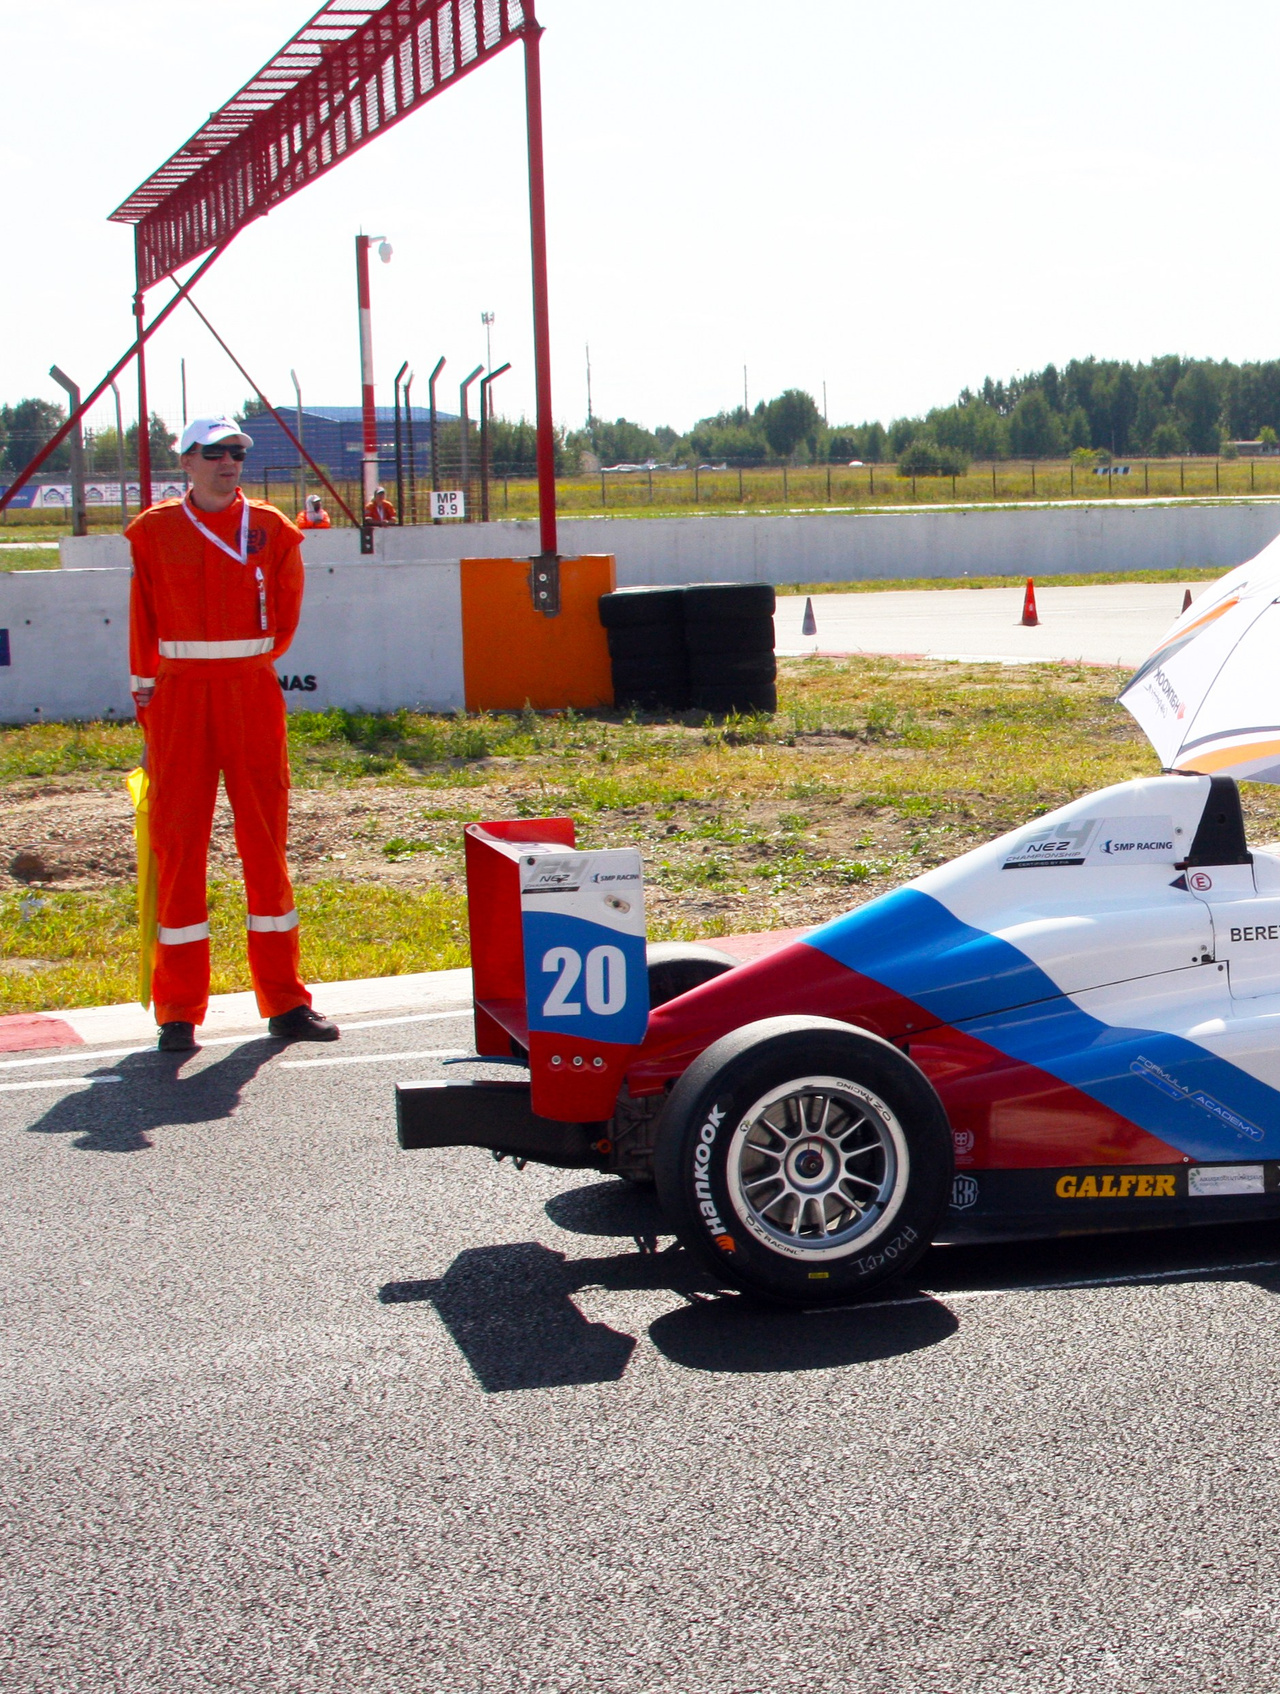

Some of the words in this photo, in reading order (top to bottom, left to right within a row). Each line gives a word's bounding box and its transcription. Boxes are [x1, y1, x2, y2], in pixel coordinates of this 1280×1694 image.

[437, 493, 457, 504] MP
[437, 504, 458, 516] 8.9
[1026, 841, 1070, 853] NEZ
[1114, 843, 1135, 851] SMP
[1137, 841, 1173, 851] RACING
[1006, 852, 1081, 862] CHAMPIONSHIP
[1196, 876, 1207, 888] E
[542, 944, 627, 1017] 20
[1137, 1055, 1189, 1094] FORMULA
[836, 1081, 873, 1104] RACING
[873, 1101, 892, 1122] OZ
[1196, 1096, 1259, 1136] ACADEMY
[1055, 1174, 1176, 1198] GALFER
[745, 1215, 765, 1236] OZ
